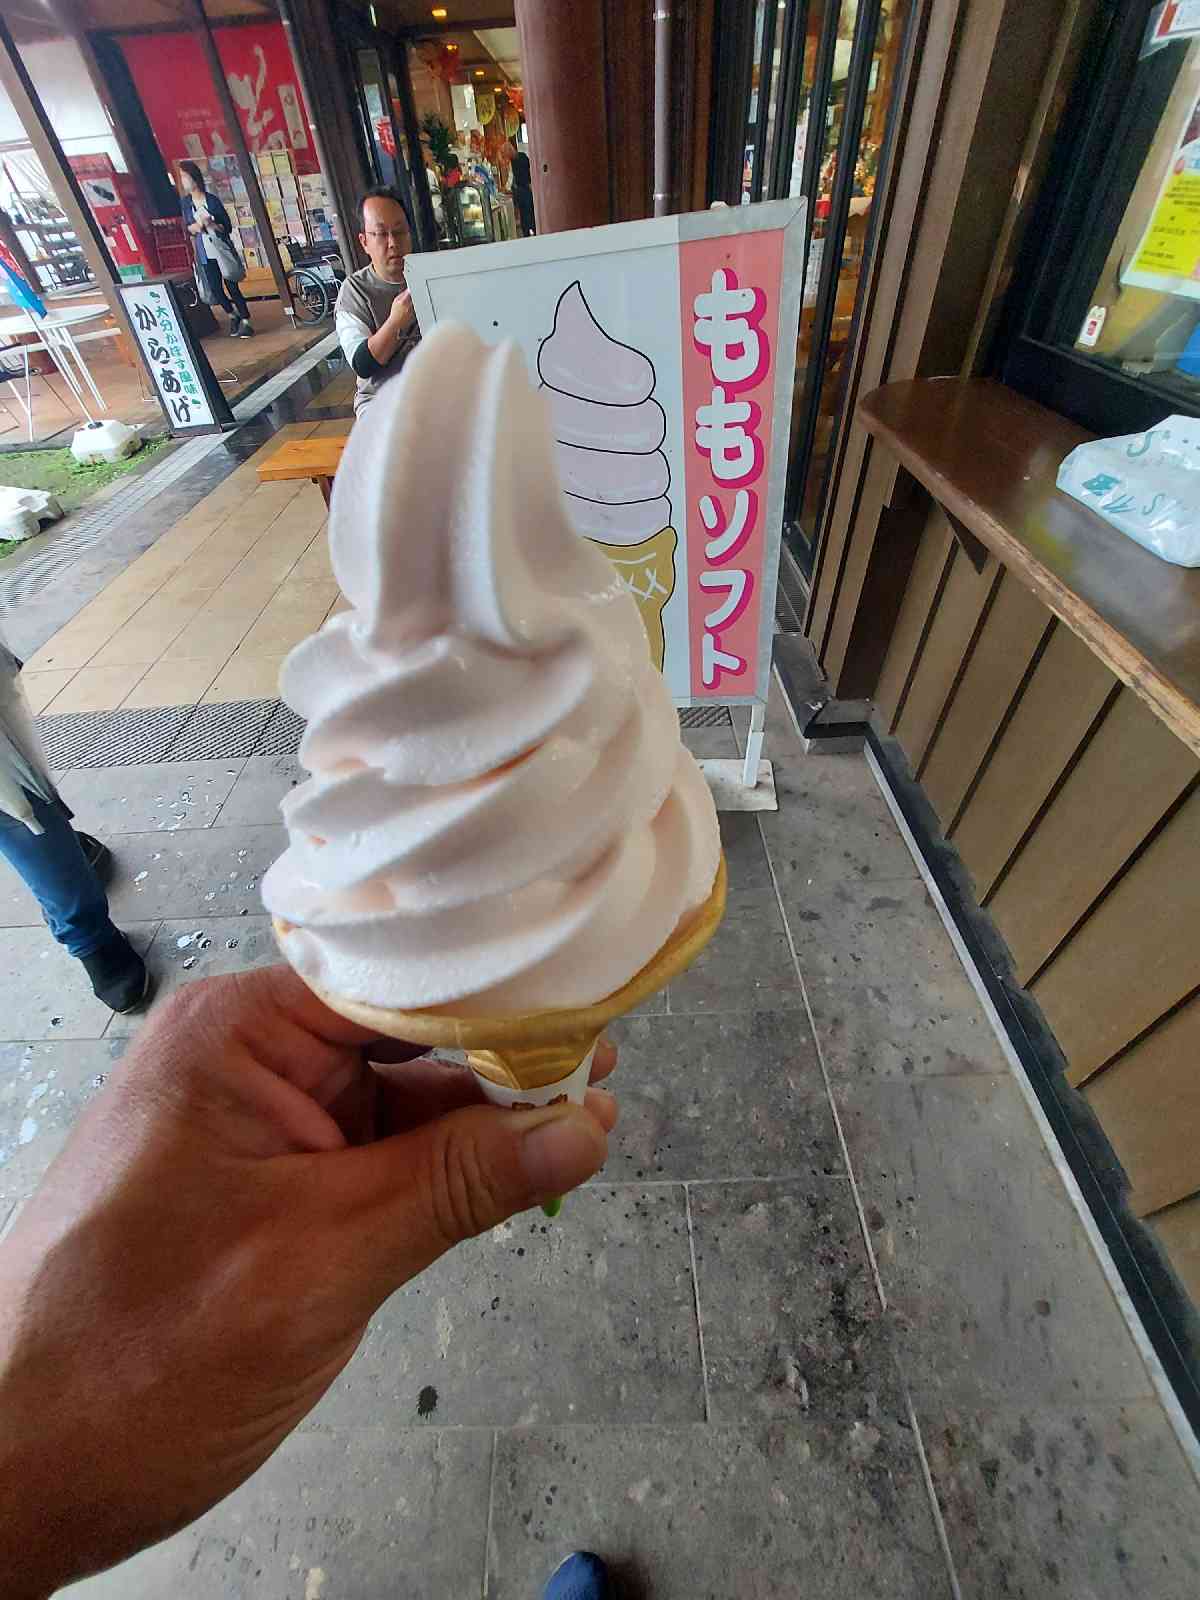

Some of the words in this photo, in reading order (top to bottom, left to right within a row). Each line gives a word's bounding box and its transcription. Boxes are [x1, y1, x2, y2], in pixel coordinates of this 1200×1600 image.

[134, 302, 191, 423] からあげ
[693, 268, 769, 690] ももソフト
